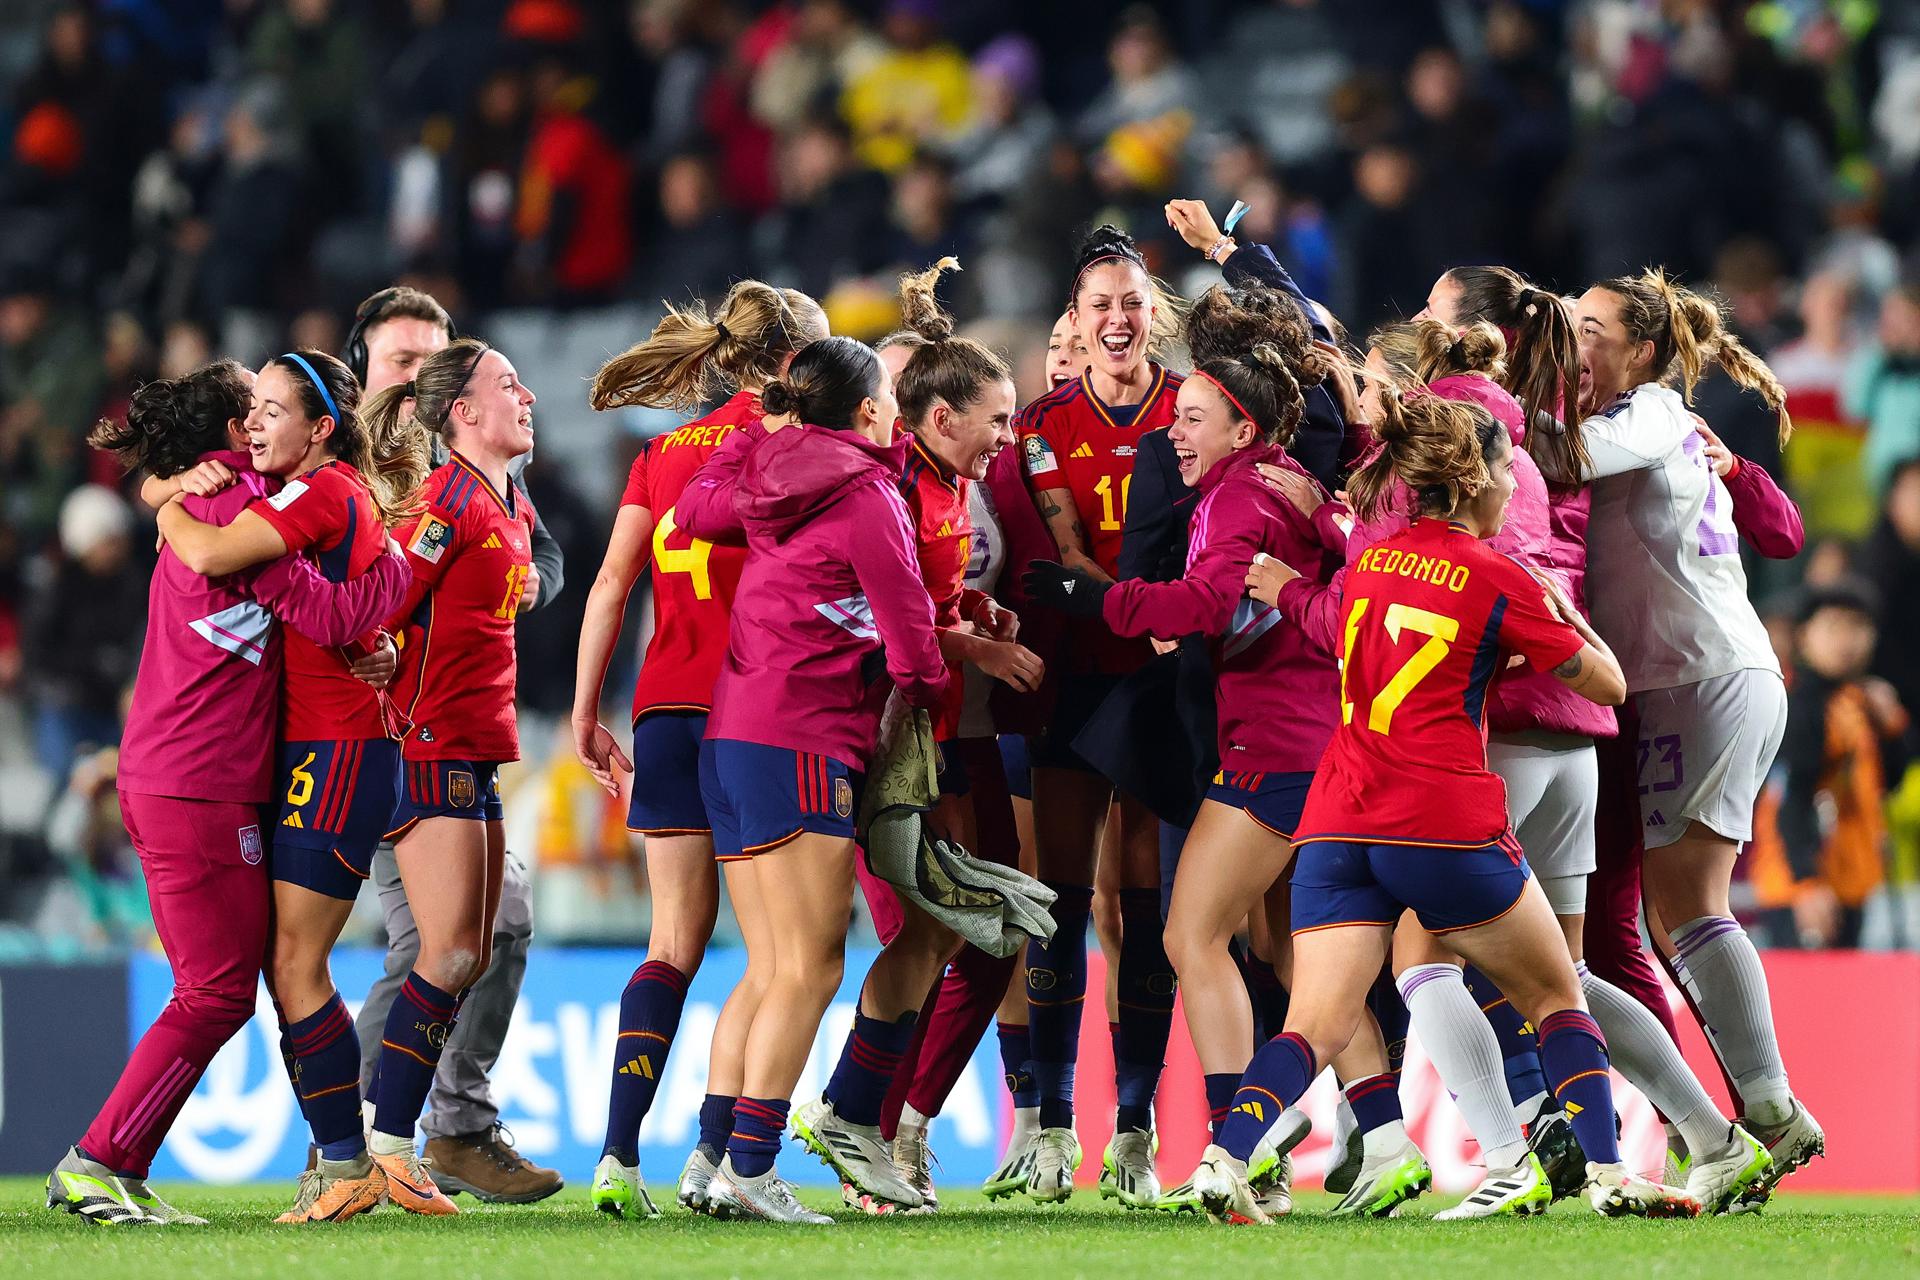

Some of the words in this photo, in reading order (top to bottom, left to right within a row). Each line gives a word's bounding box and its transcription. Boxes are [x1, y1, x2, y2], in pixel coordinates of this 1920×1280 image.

[652, 505, 715, 601] 4
[1357, 547, 1470, 593] REDONDO
[494, 564, 529, 621] 15
[1341, 598, 1460, 737] 17
[287, 752, 316, 807] 6
